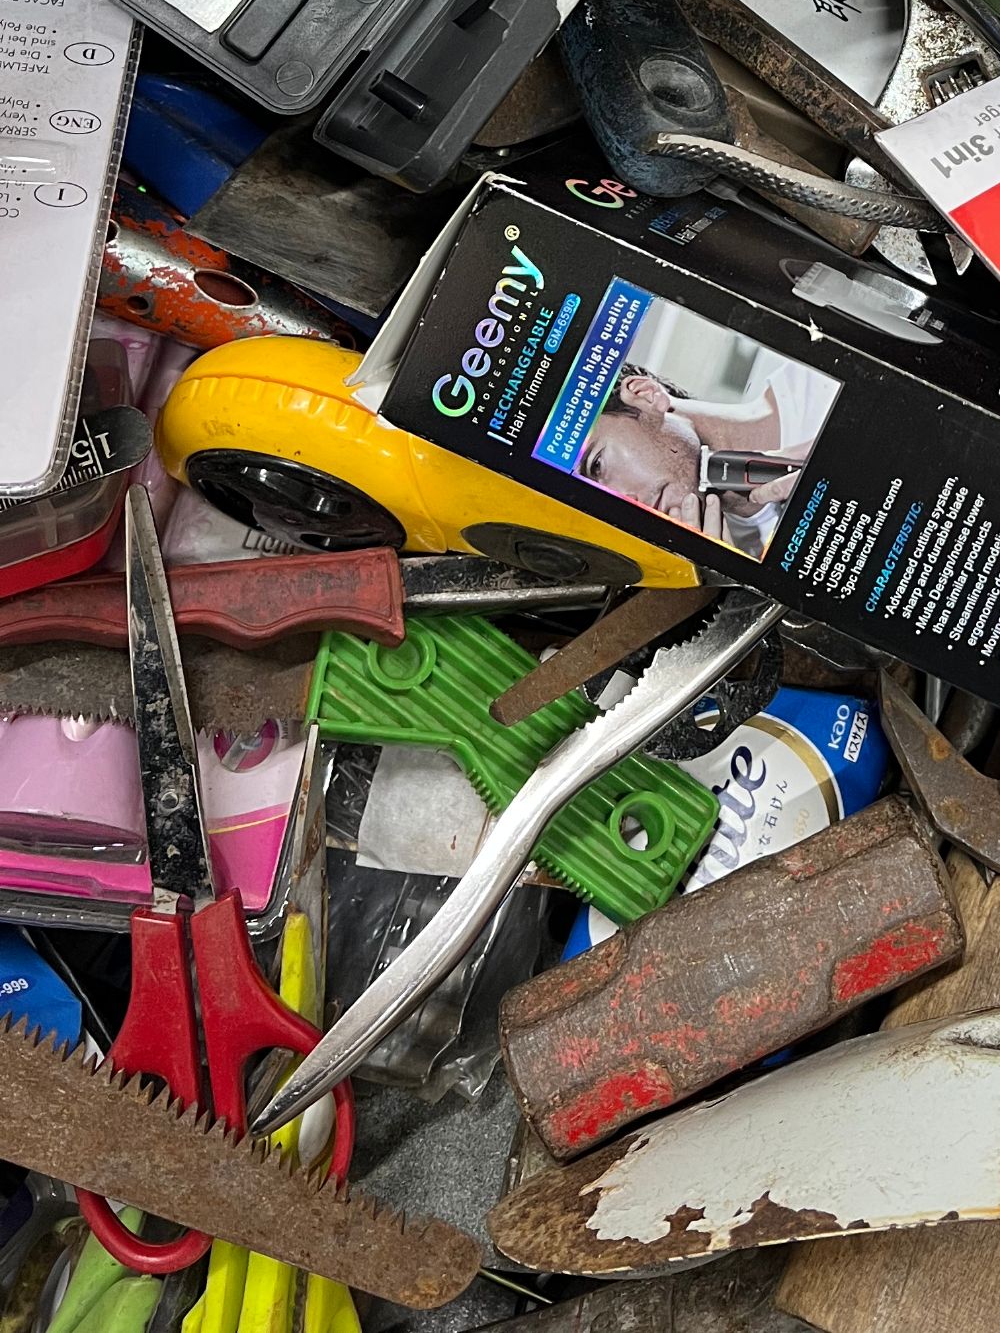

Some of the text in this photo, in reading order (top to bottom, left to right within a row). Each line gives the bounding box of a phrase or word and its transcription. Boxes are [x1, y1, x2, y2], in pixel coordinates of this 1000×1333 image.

[20, 49, 40, 59] Die
[26, 23, 47, 35] Die
[31, 37, 56, 46] sind
[82, 48, 97, 60] D
[0, 110, 27, 123] Very
[56, 115, 95, 129] ENG
[565, 179, 638, 209] Ge
[930, 133, 994, 179] 3in1
[431, 244, 545, 417] Geemy
[472, 289, 539, 425] PROFESSIONAL
[489, 306, 554, 431] RECHARGEABLE
[507, 298, 577, 439] Hair Trimmer GM-6590
[546, 293, 629, 455] Professional high quality
[560, 298, 642, 460] advanced shaving system
[780, 478, 830, 572] ACCESSORIES:
[802, 498, 842, 577] Lubricating oil
[813, 499, 859, 583] Cleaning brush
[827, 513, 872, 590] USB charging
[842, 477, 903, 597] 3pc haircut limit comb
[865, 500, 924, 613] CHARACTERISTIC:
[885, 476, 959, 616] Advanced cutting system,
[902, 486, 969, 619] sharp and durable blade
[915, 493, 986, 631] Mute Design/noise lower
[932, 519, 993, 635] than similar products
[949, 572, 988, 642] Streamlined
[967, 587, 1000, 647] ergonomic
[828, 704, 851, 750] kao
[847, 711, 868, 762] バスサイズ
[756, 779, 789, 856] な石けん
[0, 978, 29, 996] -999
